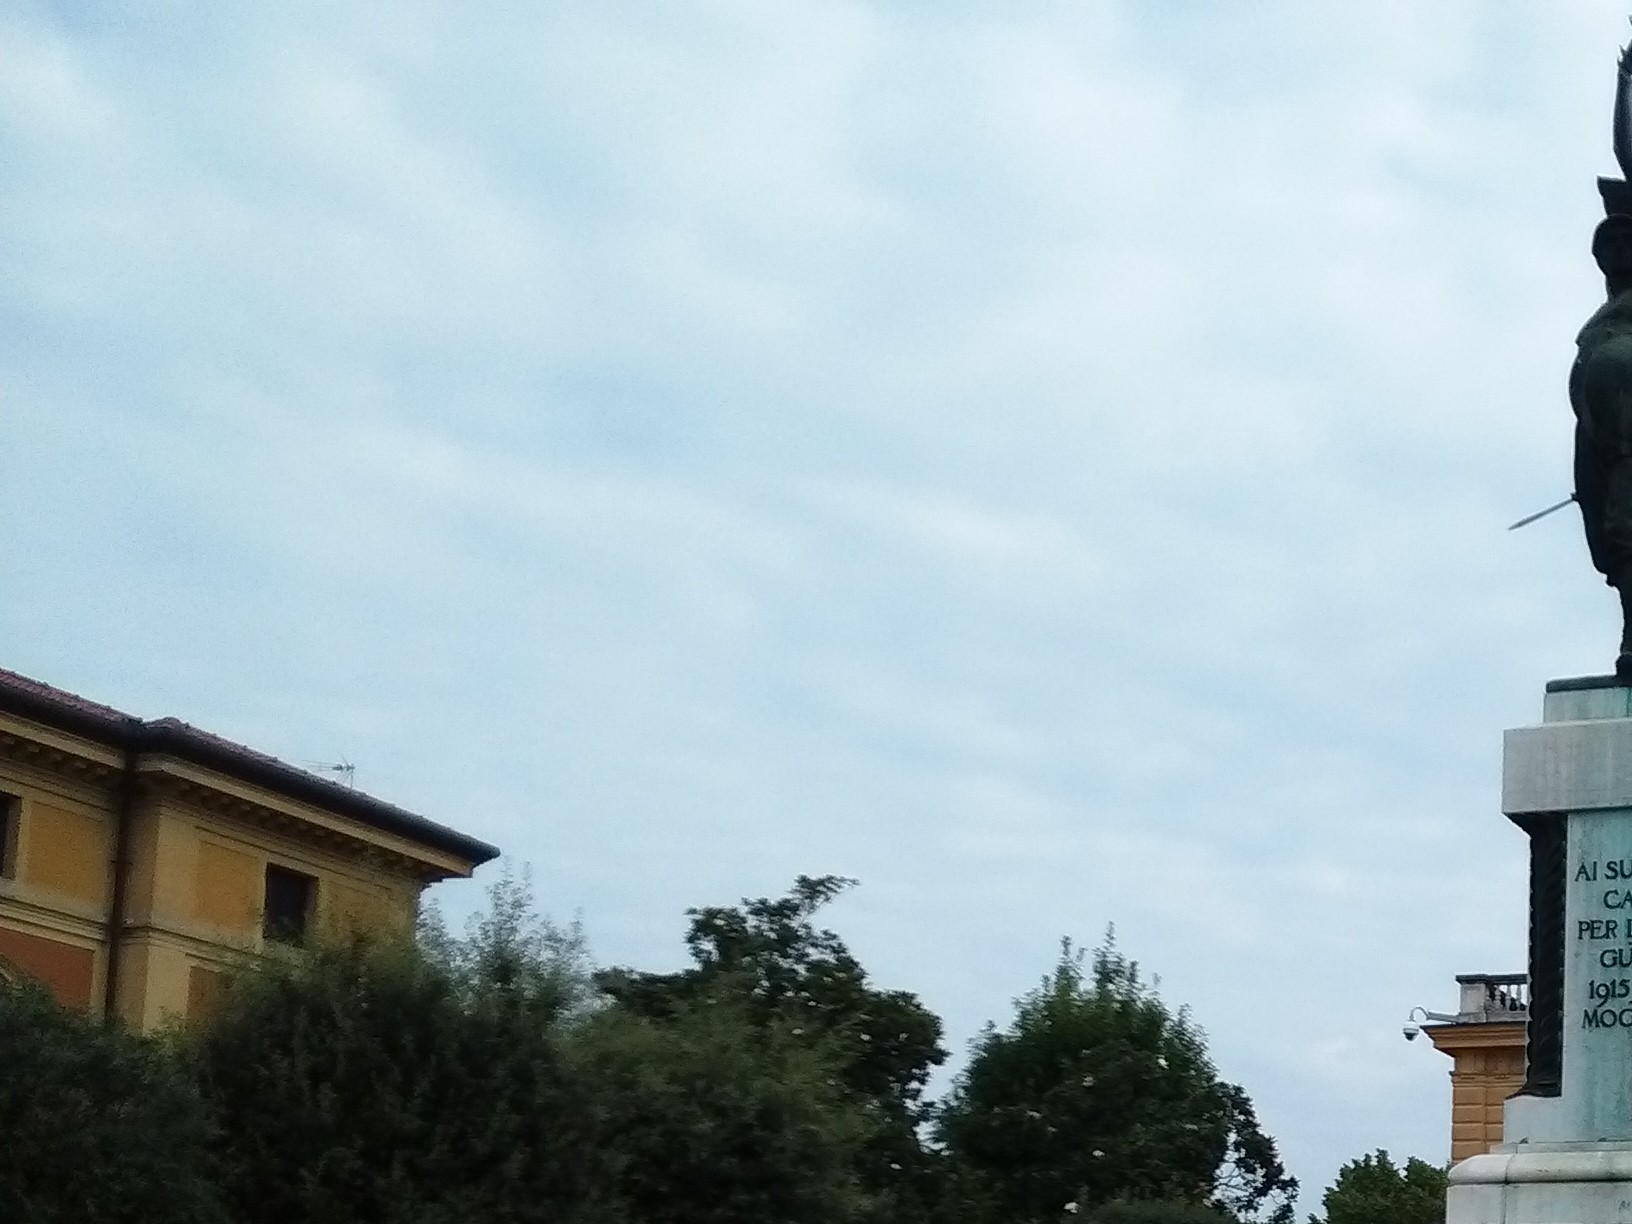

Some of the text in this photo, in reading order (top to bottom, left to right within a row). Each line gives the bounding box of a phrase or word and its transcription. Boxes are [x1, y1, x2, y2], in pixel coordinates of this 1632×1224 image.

[1573, 861, 1599, 882] AI
[1577, 919, 1618, 941] PER
[1588, 979, 1630, 1009] 1915
